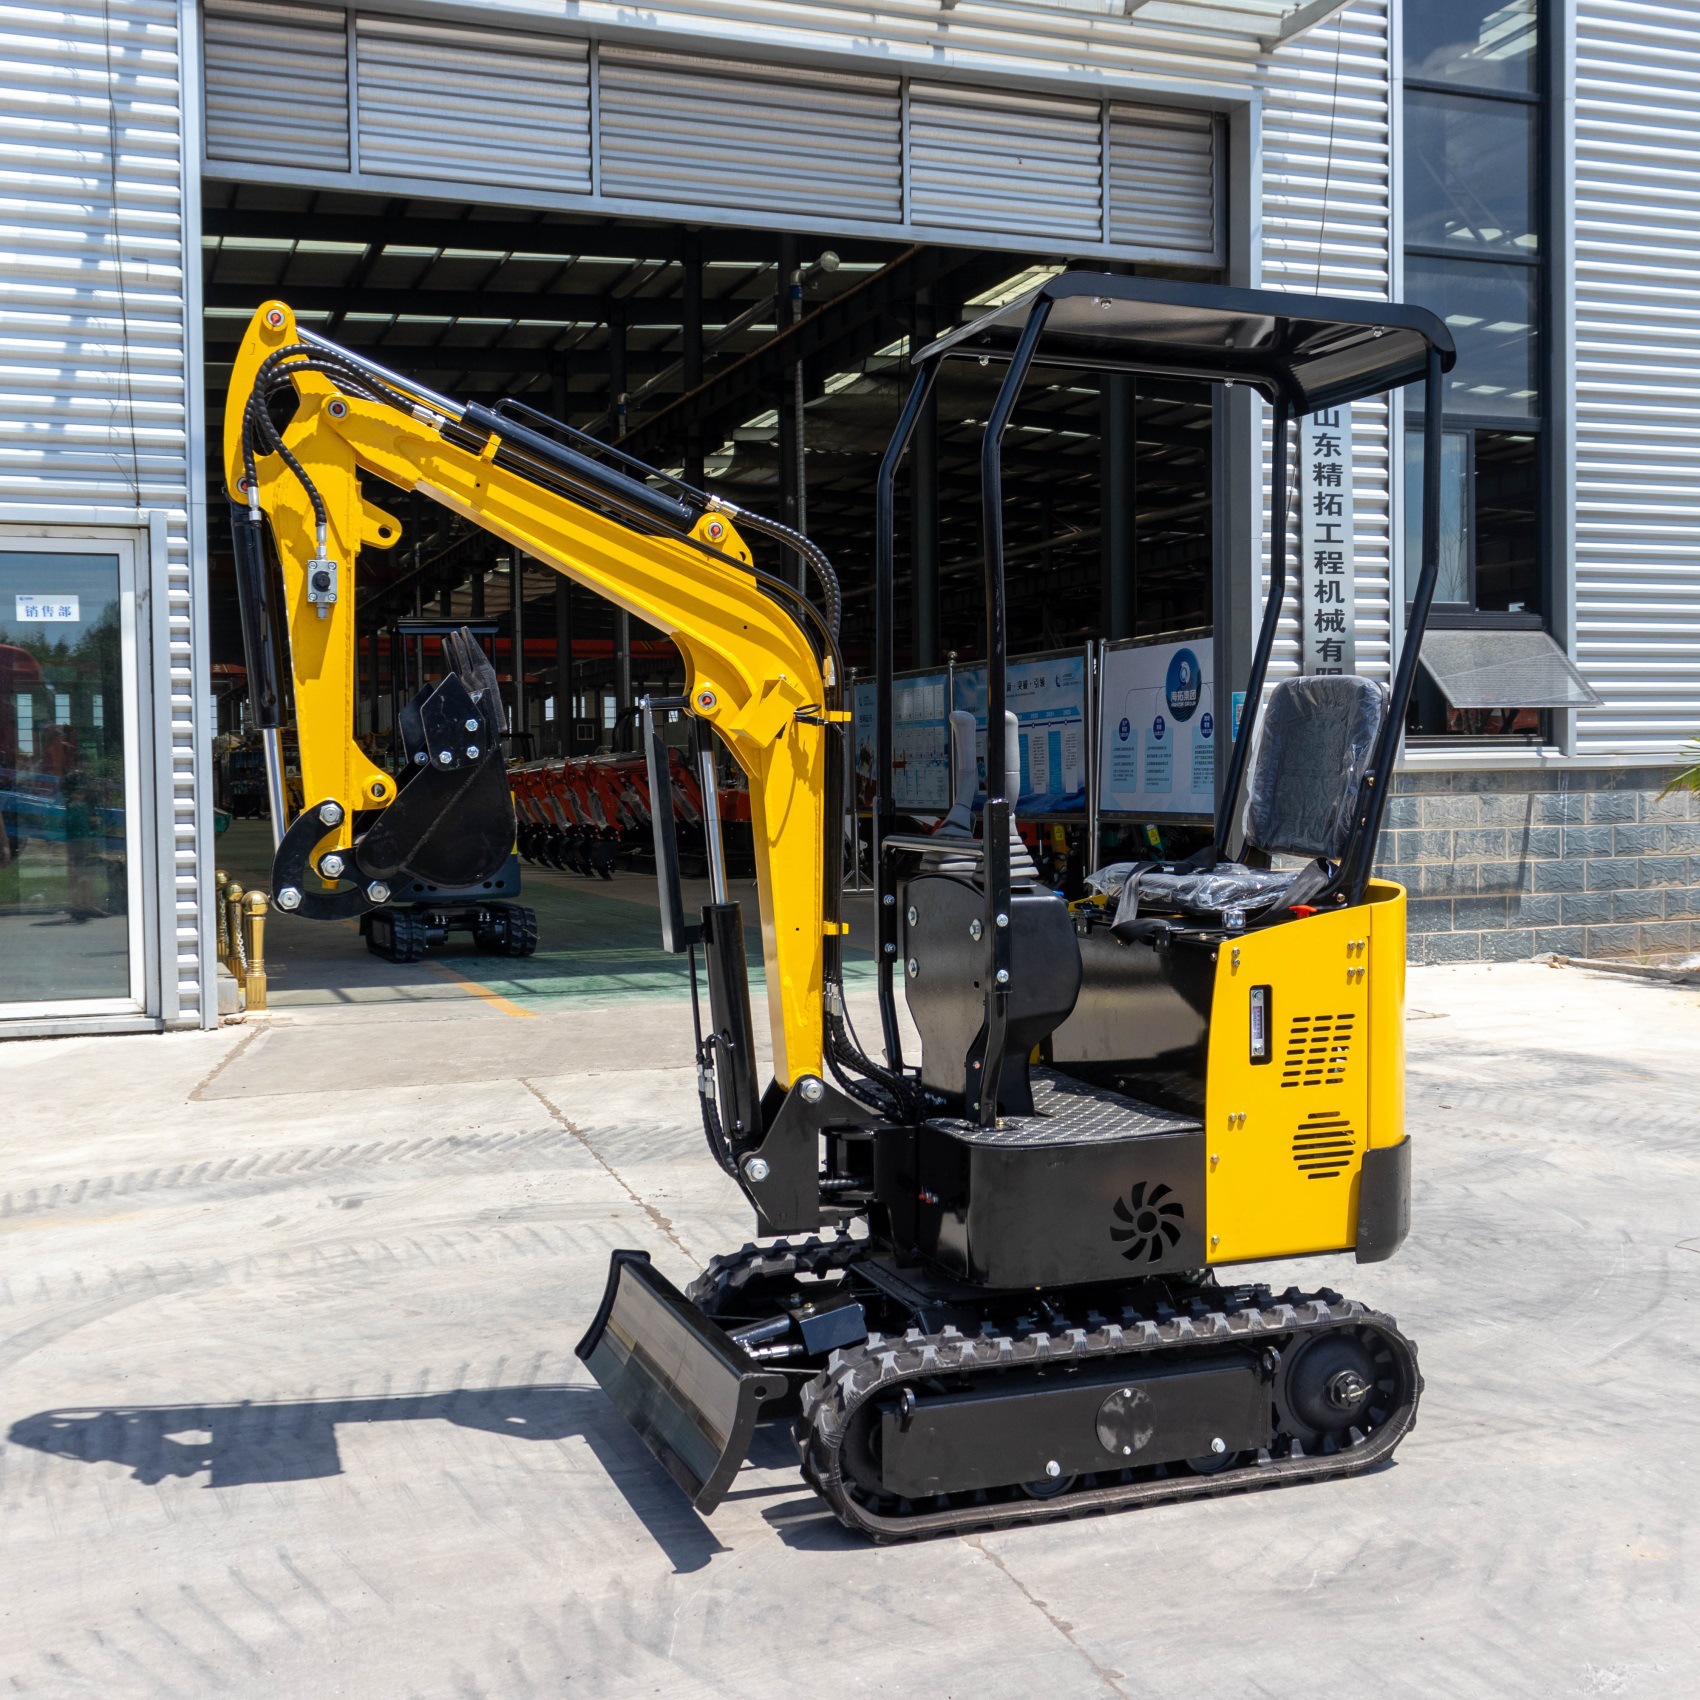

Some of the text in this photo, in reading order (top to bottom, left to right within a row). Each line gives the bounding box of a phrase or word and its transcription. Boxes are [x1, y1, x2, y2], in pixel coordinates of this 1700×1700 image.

[25, 605, 72, 618] 销售部
[1170, 689, 1197, 702] 海拓集团
